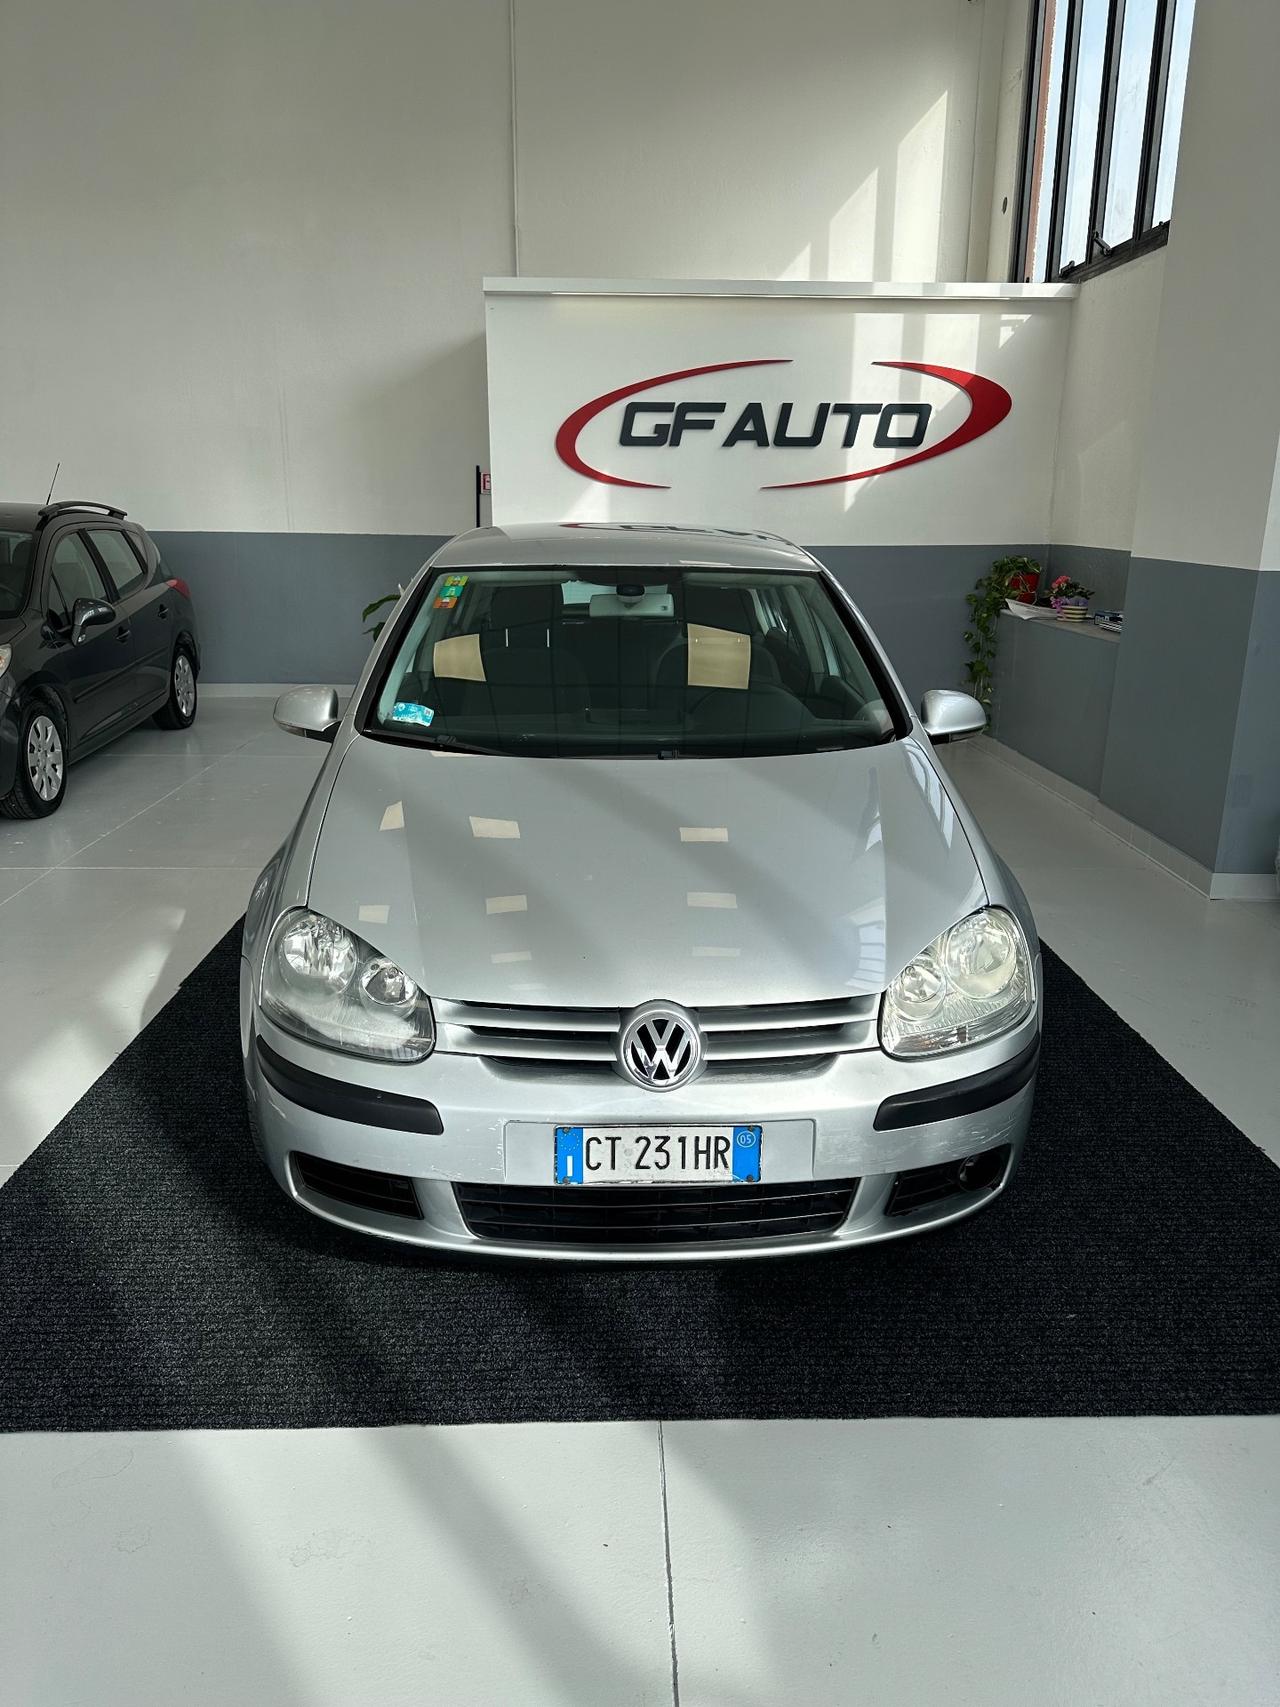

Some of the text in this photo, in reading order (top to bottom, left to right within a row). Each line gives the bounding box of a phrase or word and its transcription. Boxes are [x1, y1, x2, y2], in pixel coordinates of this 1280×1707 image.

[626, 1014, 695, 1084] VW
[585, 1136, 622, 1171] CT
[740, 1134, 752, 1145] 05
